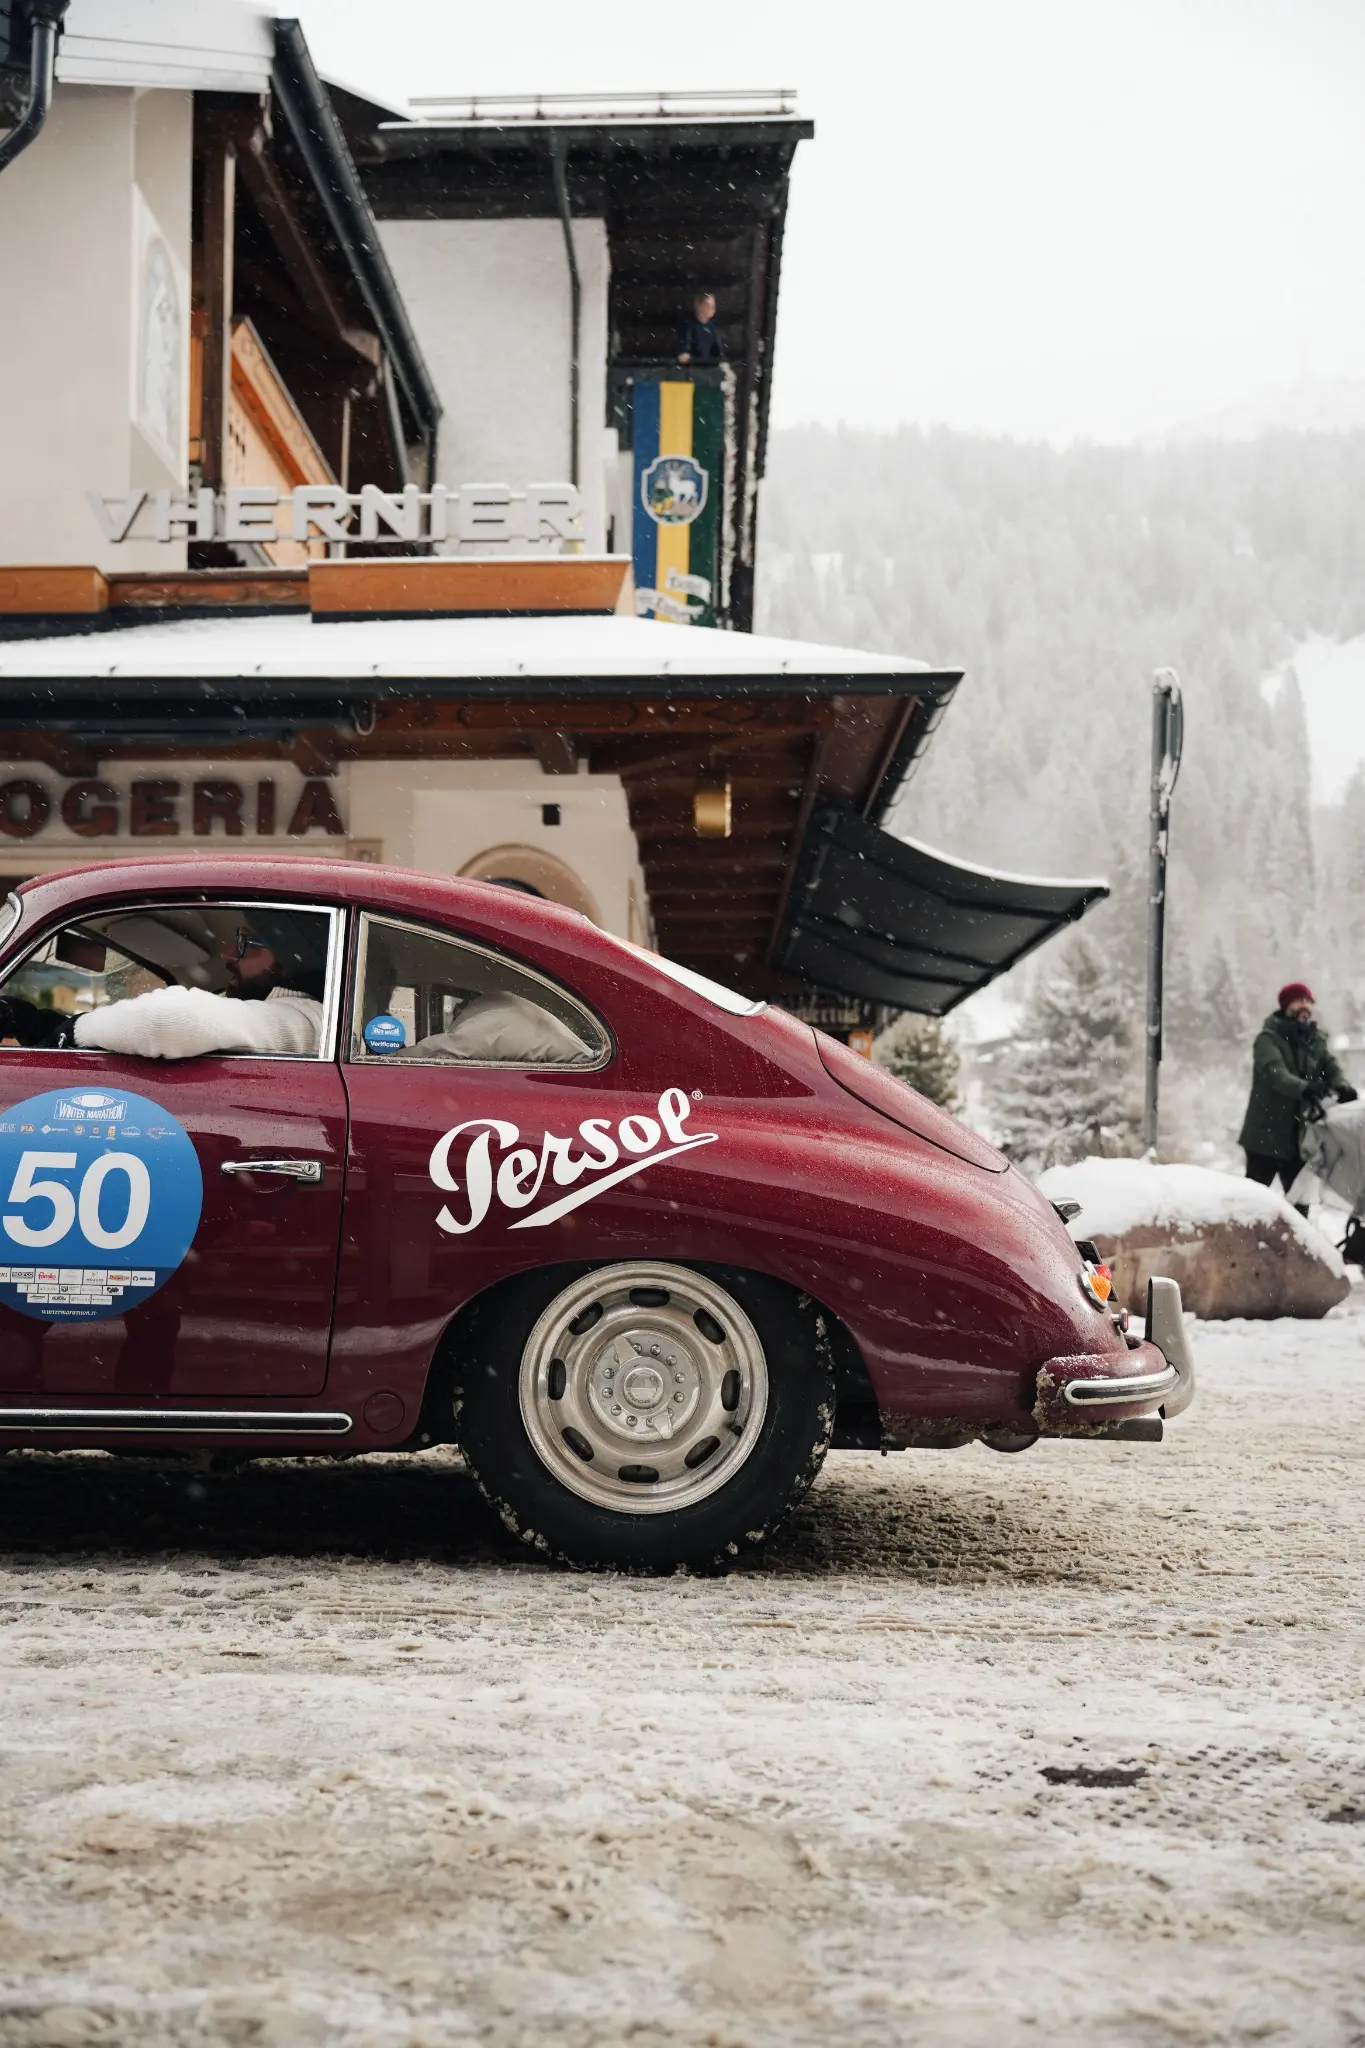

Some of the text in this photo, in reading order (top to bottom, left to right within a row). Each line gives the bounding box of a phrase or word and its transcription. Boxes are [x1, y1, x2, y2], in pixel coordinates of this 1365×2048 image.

[86, 483, 585, 543] VHERNIER
[0, 779, 346, 838] OGERIA
[59, 1100, 86, 1119] WINTER
[86, 1102, 124, 1120] MARATHON
[428, 1087, 719, 1235] Persol
[2, 1151, 151, 1250] 50
